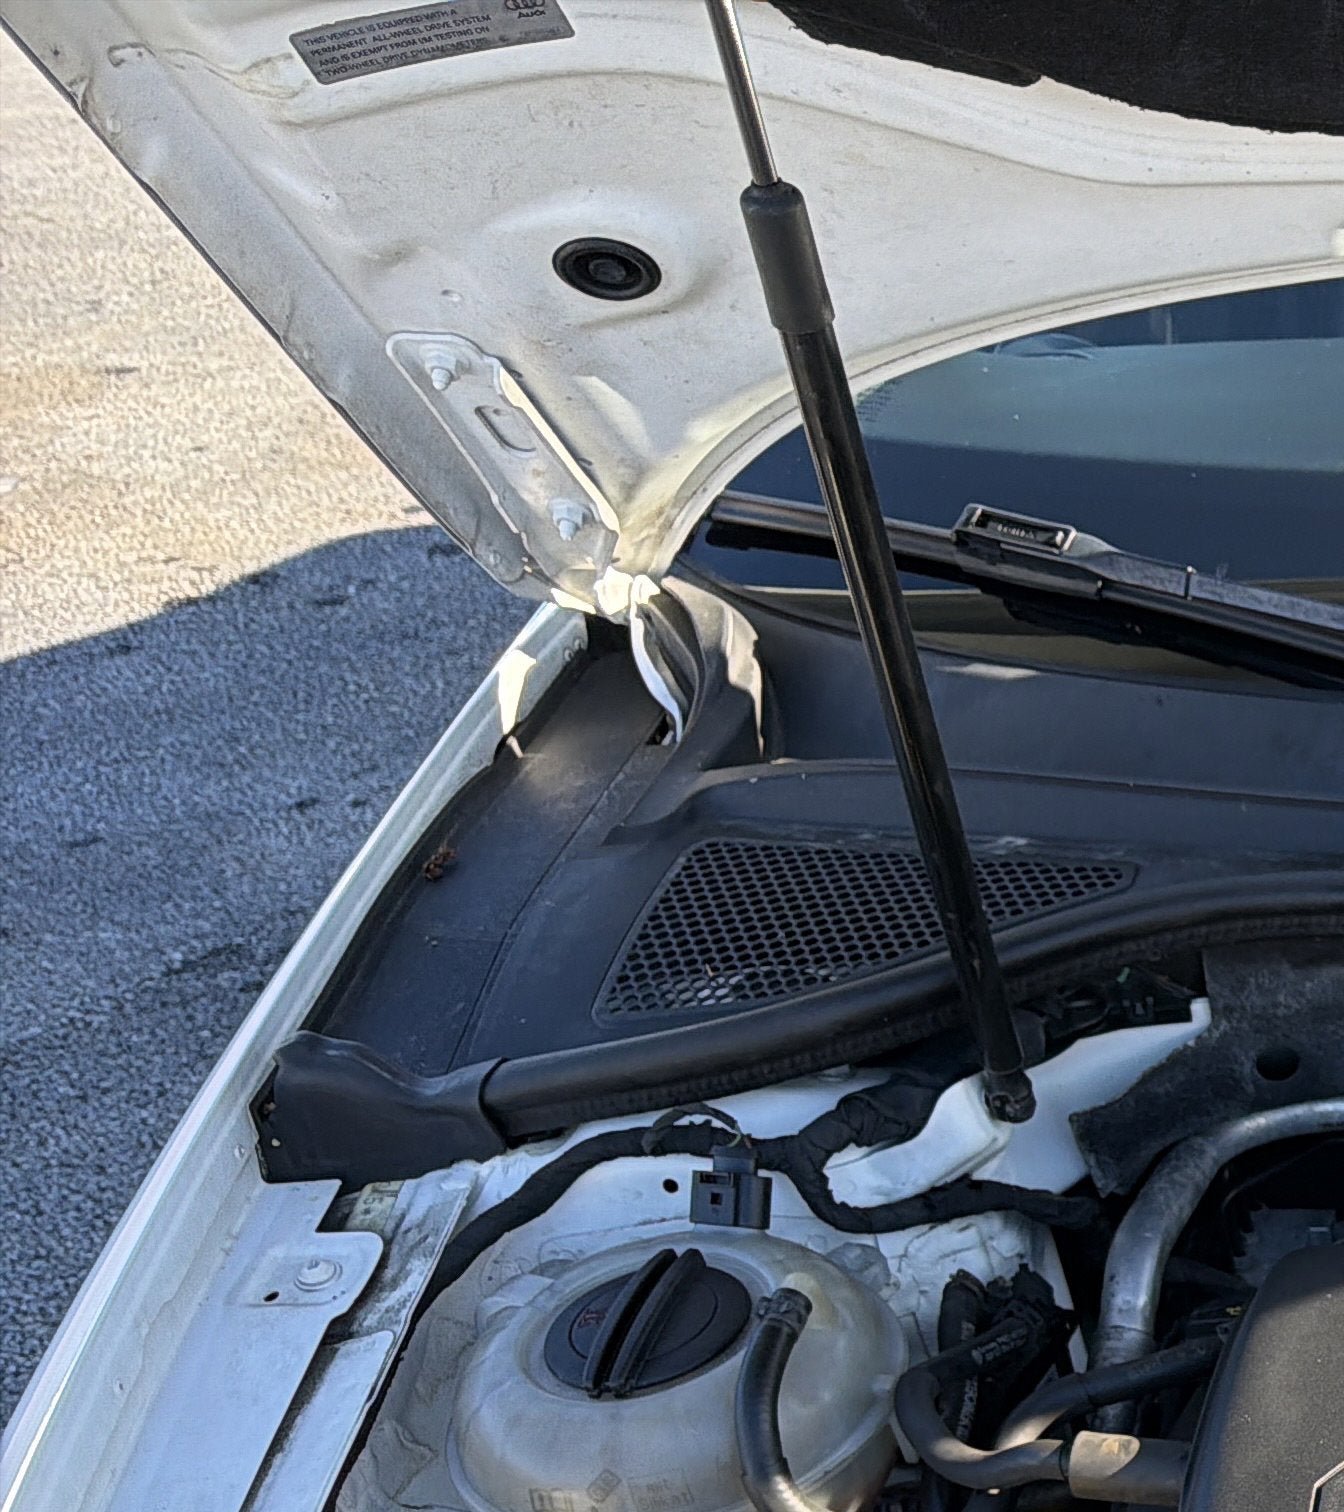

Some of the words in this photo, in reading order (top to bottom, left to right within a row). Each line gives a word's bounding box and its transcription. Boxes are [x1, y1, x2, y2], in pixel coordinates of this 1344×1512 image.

[304, 37, 326, 46] THIS
[376, 15, 423, 31] EQUIPPED
[310, 38, 368, 56] PERMANENT
[372, 27, 423, 43] ALL-WHEEL
[424, 20, 453, 33] DRIVE
[453, 14, 492, 27] SYSTEM
[350, 43, 388, 59] EXEMPT
[389, 37, 418, 50] FROM
[436, 27, 473, 42] TESTING
